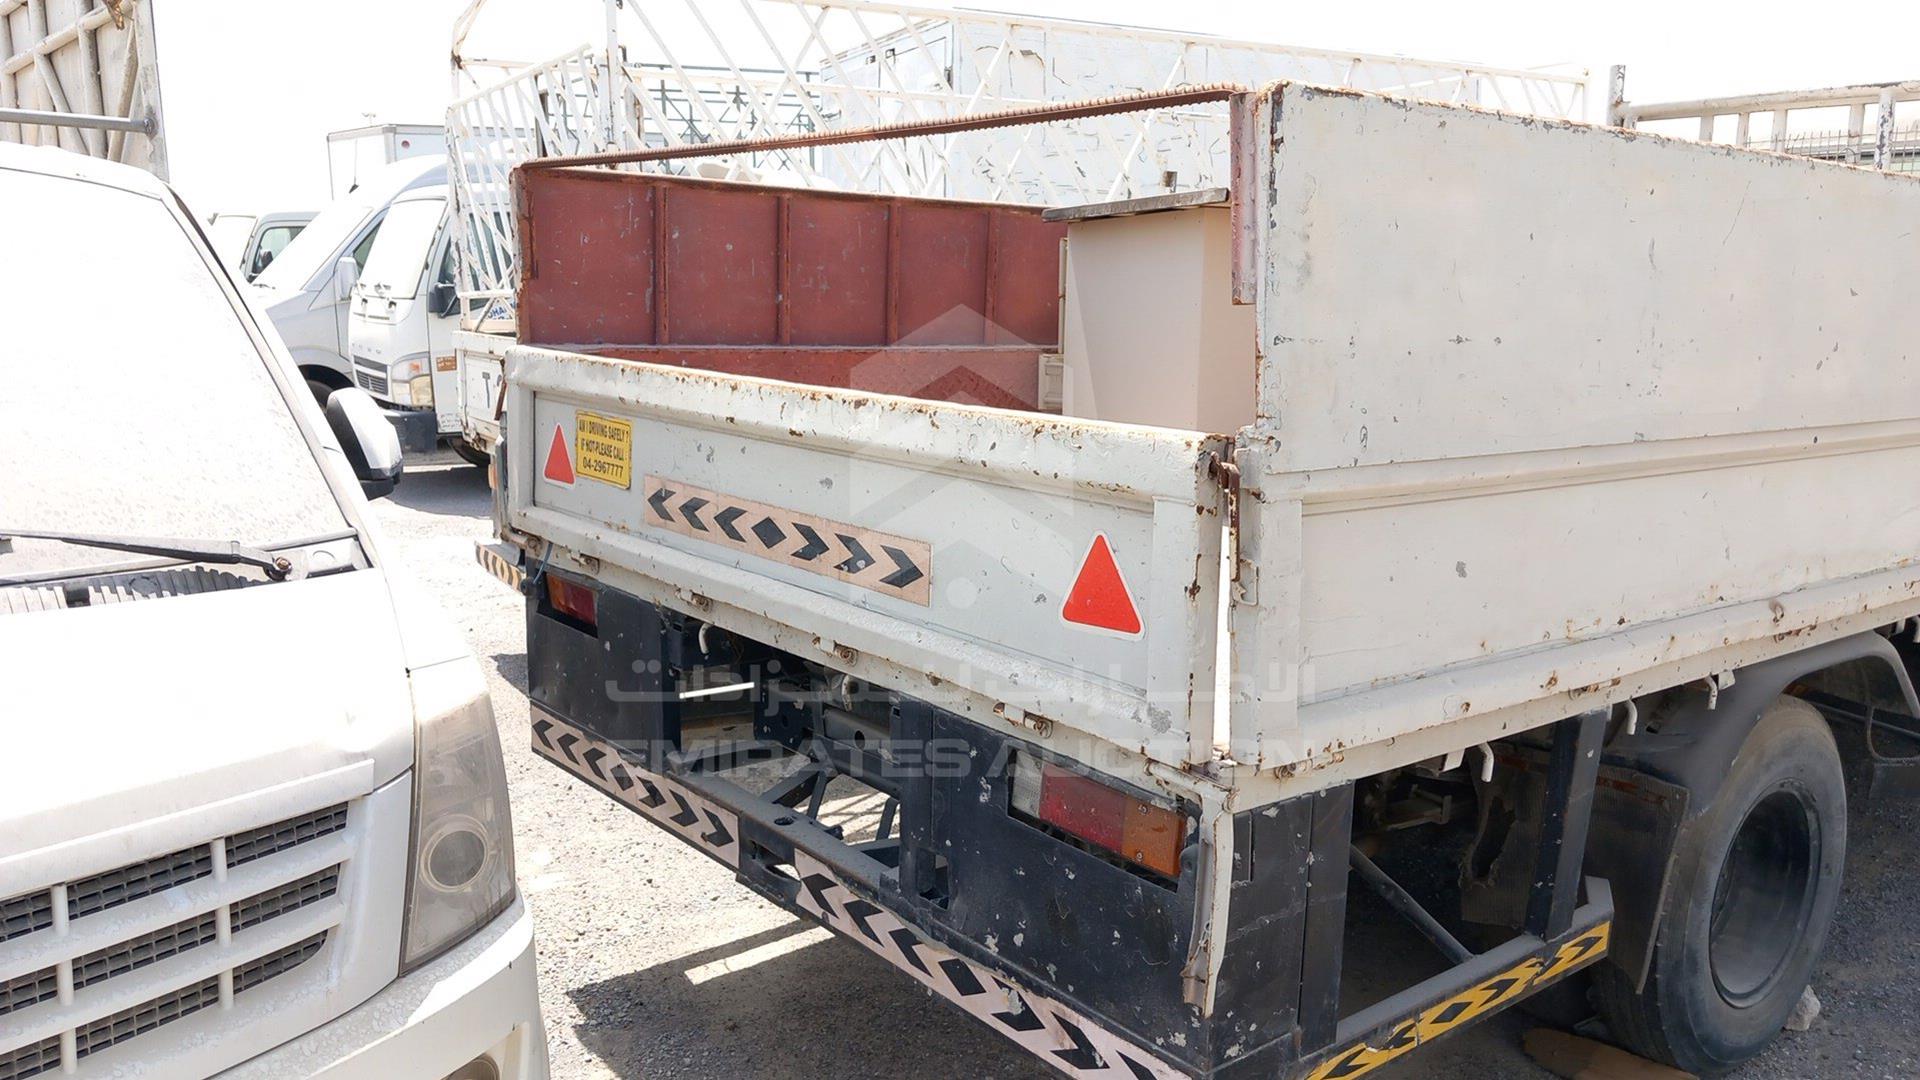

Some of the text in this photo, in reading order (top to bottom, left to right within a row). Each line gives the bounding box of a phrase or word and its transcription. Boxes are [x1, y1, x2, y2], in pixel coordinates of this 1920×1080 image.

[589, 421, 608, 438] DRIVING
[608, 426, 625, 443] SAFELY
[580, 438, 585, 451] IF
[583, 456, 624, 478] 04-2967777
